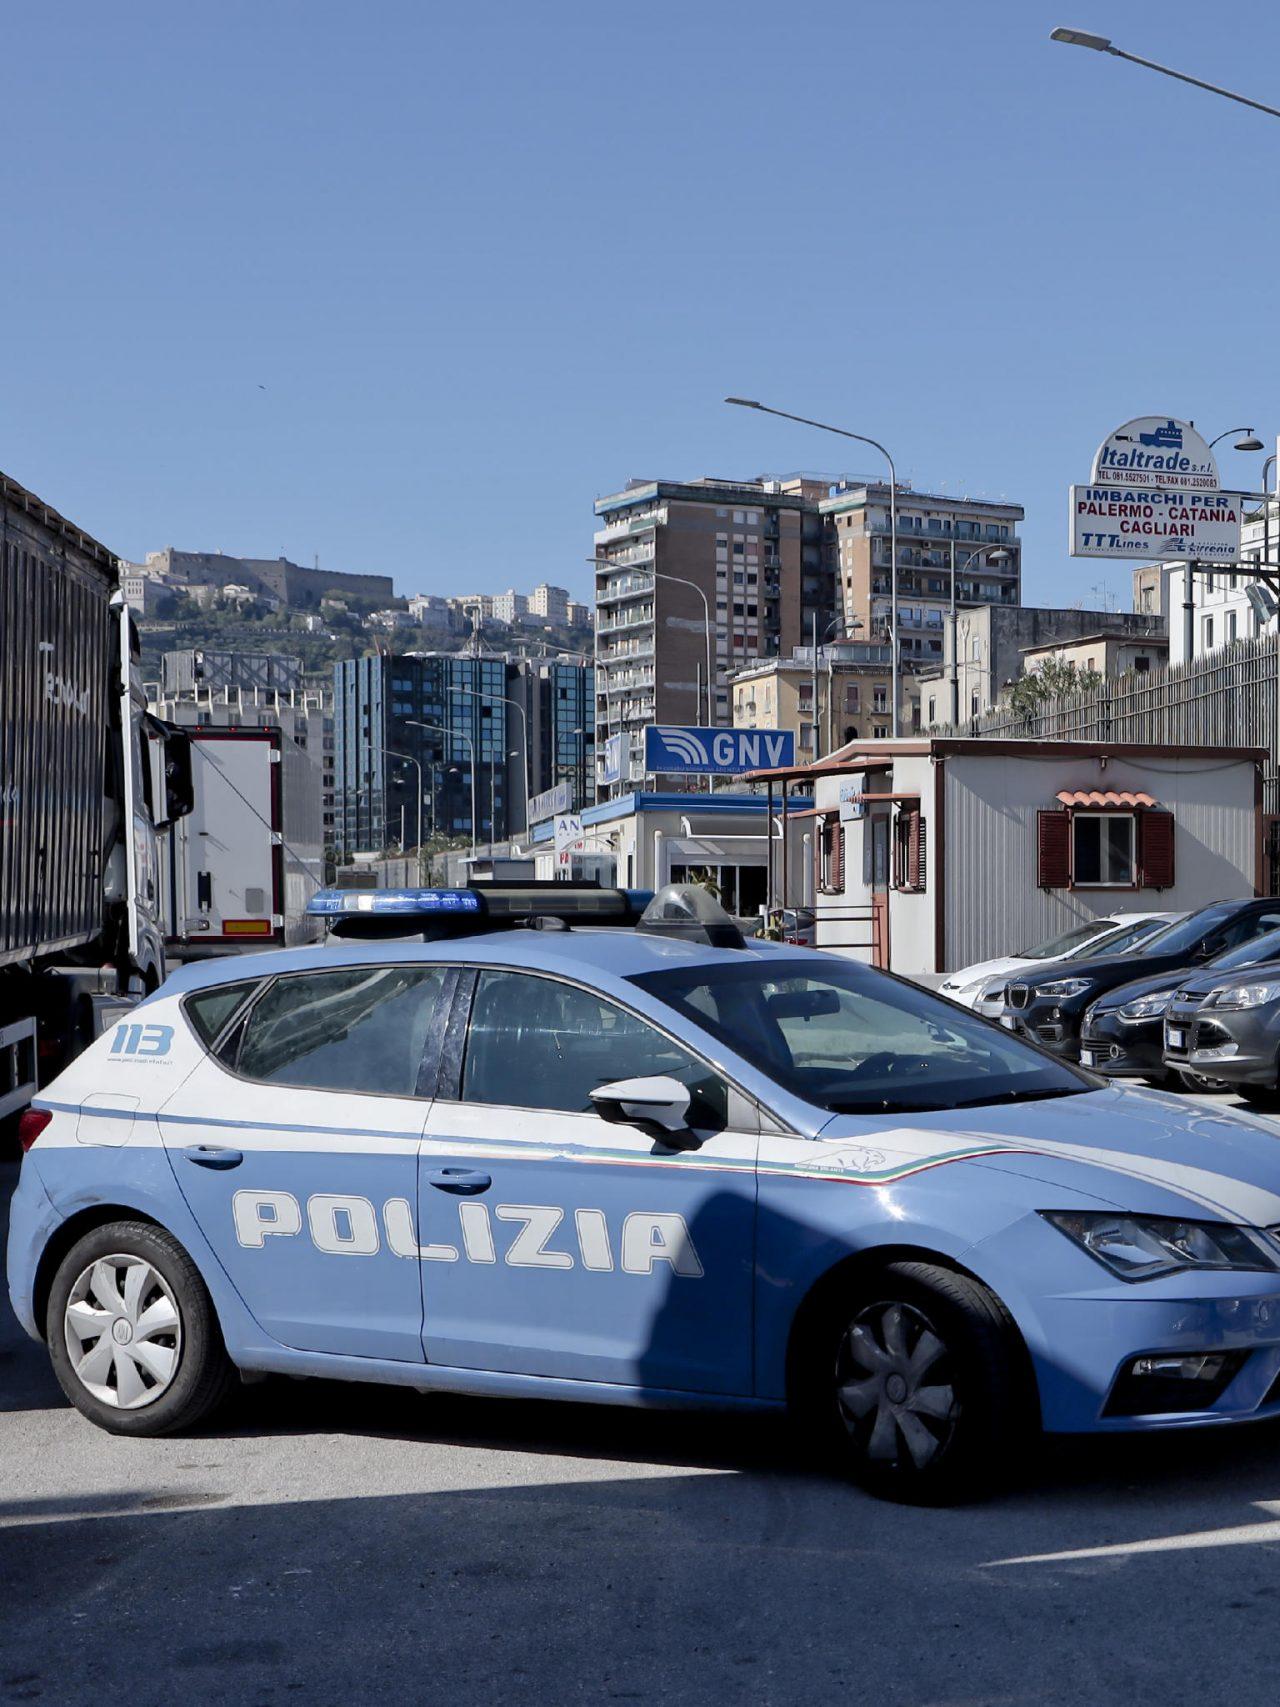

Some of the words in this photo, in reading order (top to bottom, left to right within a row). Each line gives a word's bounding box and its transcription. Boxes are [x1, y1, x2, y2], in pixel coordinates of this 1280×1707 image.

[1101, 447, 1190, 471] Italtrade
[1191, 463, 1213, 473] s.r.l.
[1078, 502, 1153, 518] PALERMO
[1168, 507, 1237, 522] CATANIA
[1086, 490, 1184, 506] IMBARCHI
[1191, 495, 1229, 508] PER
[1120, 521, 1195, 536] CAGLIARI
[712, 733, 785, 767] GNV
[110, 1024, 175, 1056] 113
[232, 1189, 704, 1278] POLIZIA
